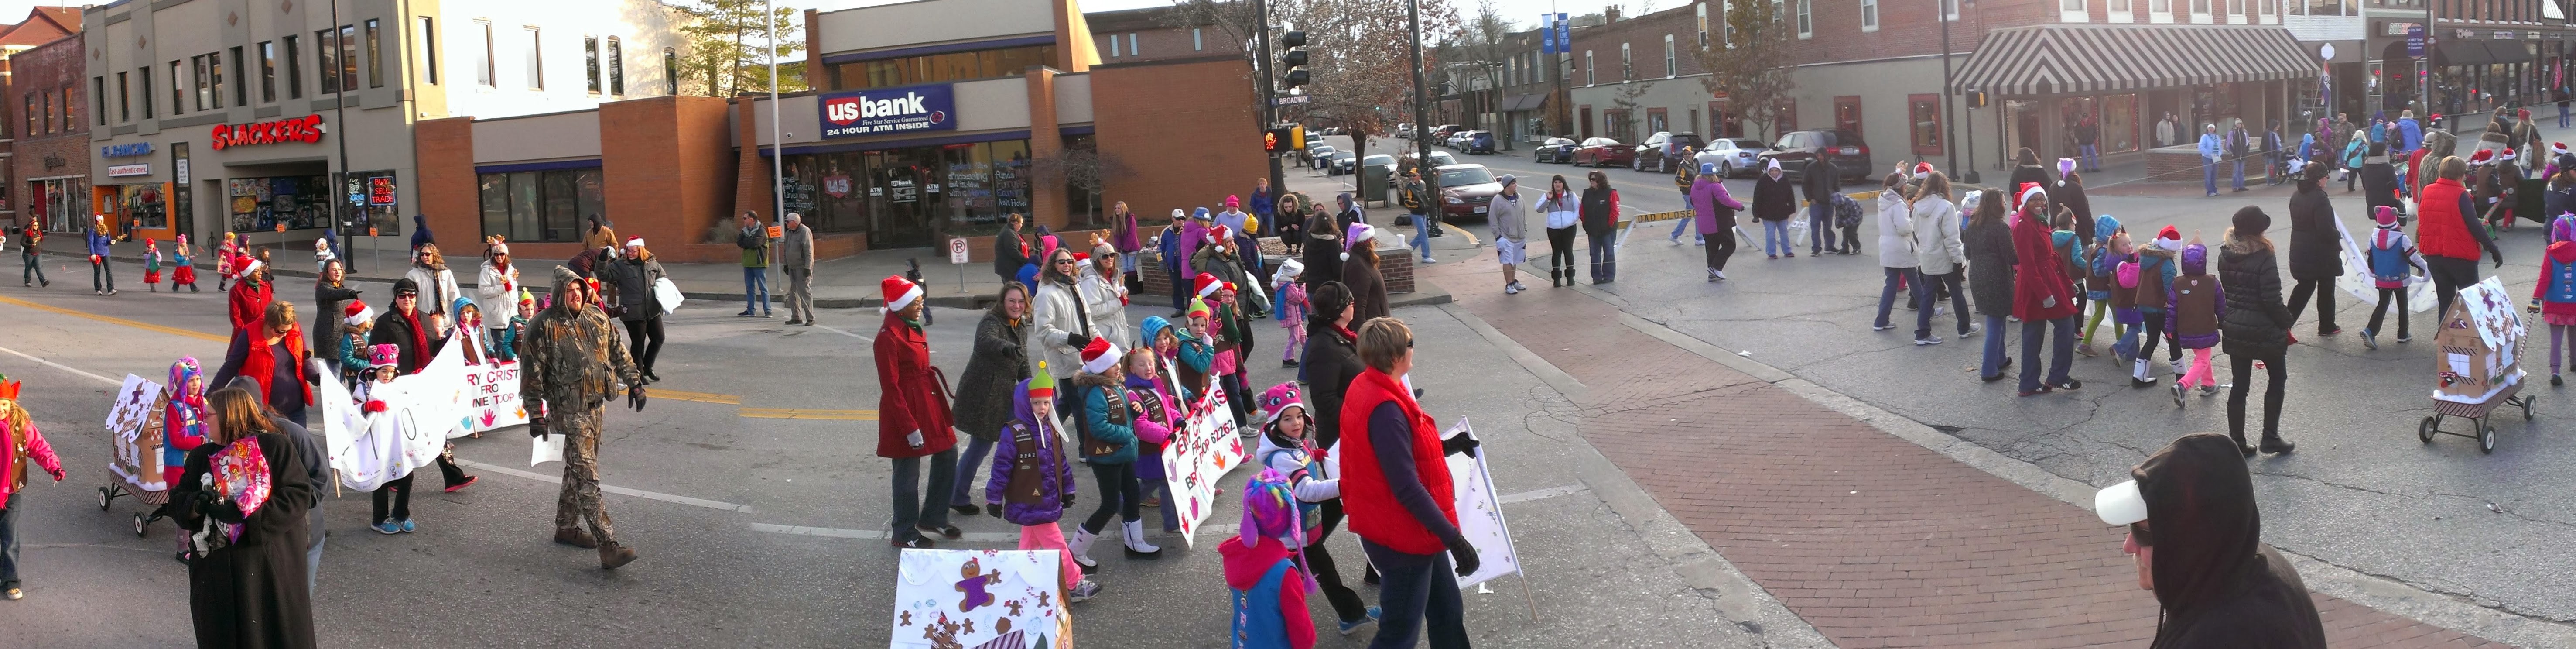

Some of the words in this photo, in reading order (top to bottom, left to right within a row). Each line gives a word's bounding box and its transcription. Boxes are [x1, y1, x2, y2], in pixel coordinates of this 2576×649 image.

[1279, 96, 1308, 105] BROADWAY
[212, 114, 321, 151] SLACKERS
[843, 126, 869, 134] HOUR
[896, 122, 929, 130] INSIDE
[827, 179, 849, 193] US
[1210, 419, 1235, 444] 62262
